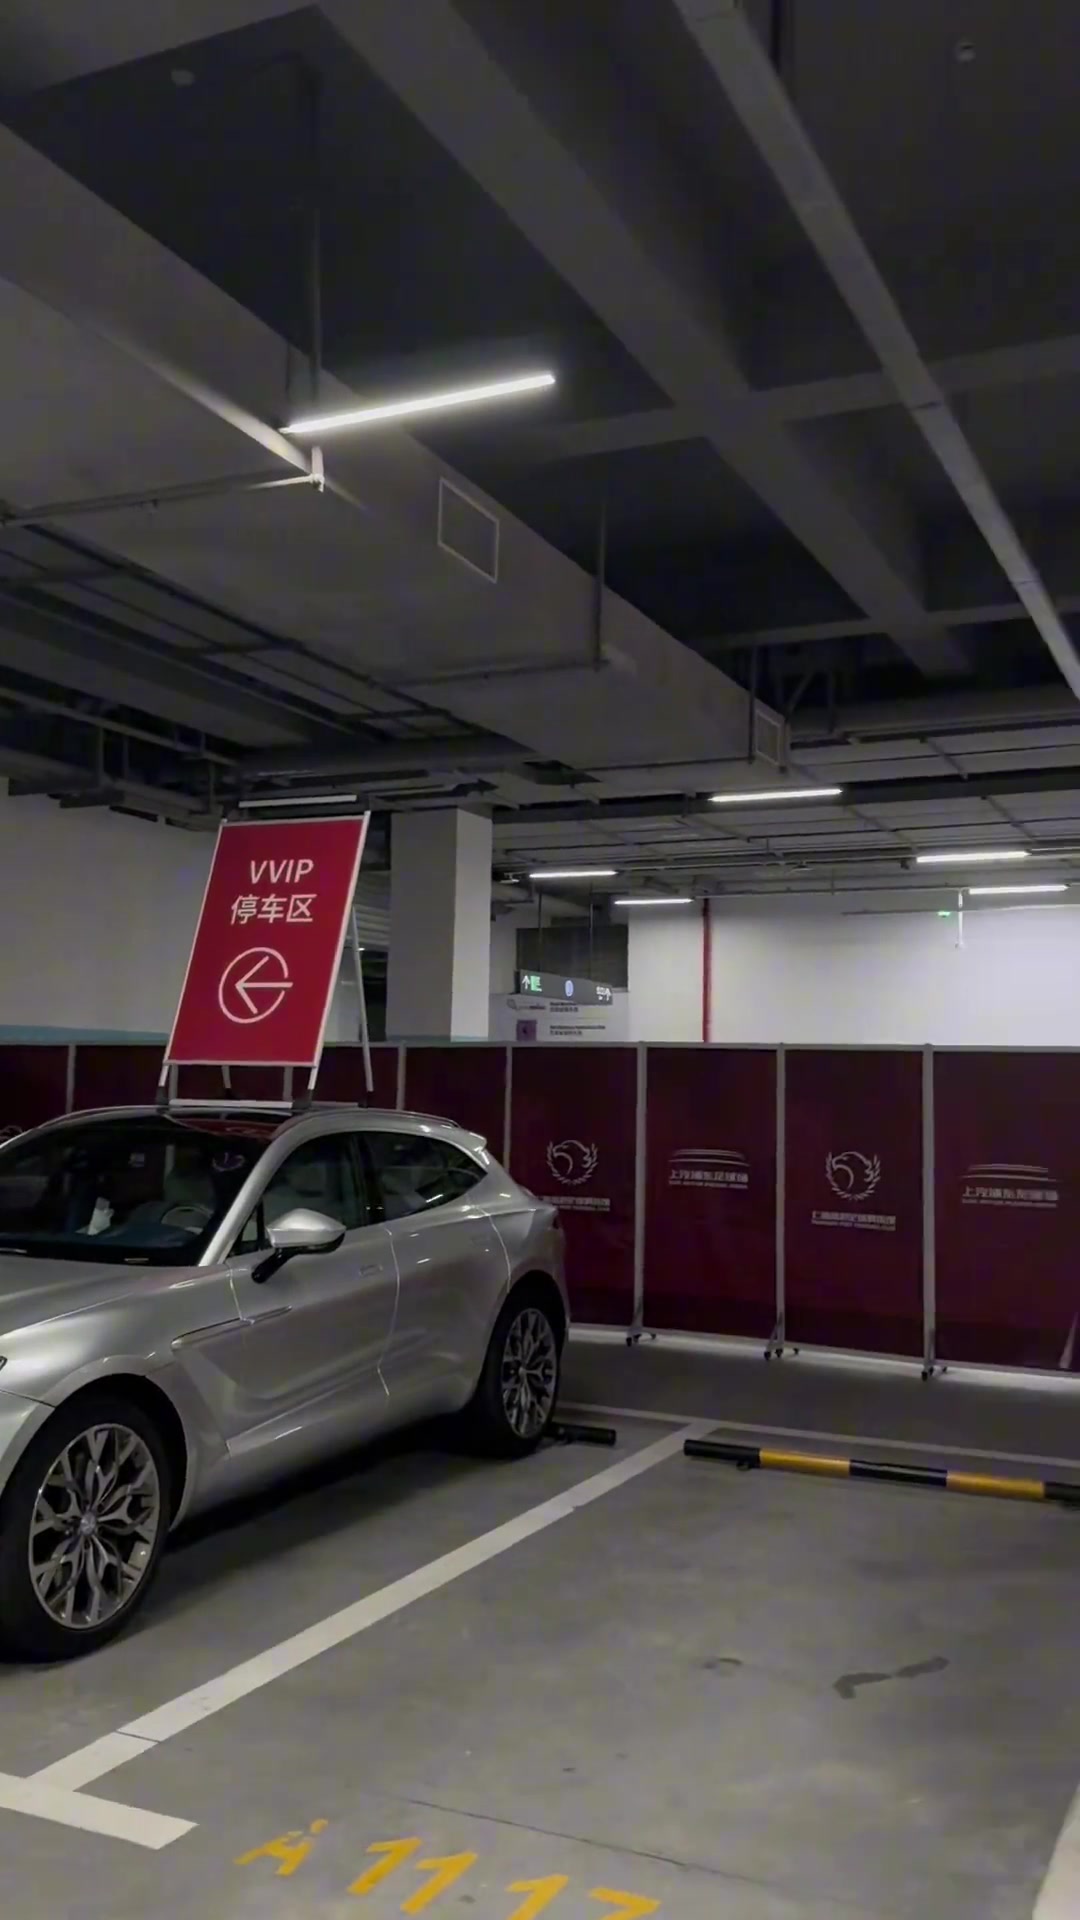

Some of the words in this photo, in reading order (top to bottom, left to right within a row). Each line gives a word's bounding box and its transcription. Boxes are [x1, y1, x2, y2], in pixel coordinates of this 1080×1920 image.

[250, 859, 314, 884] VVIP
[230, 893, 318, 925] 停车区
